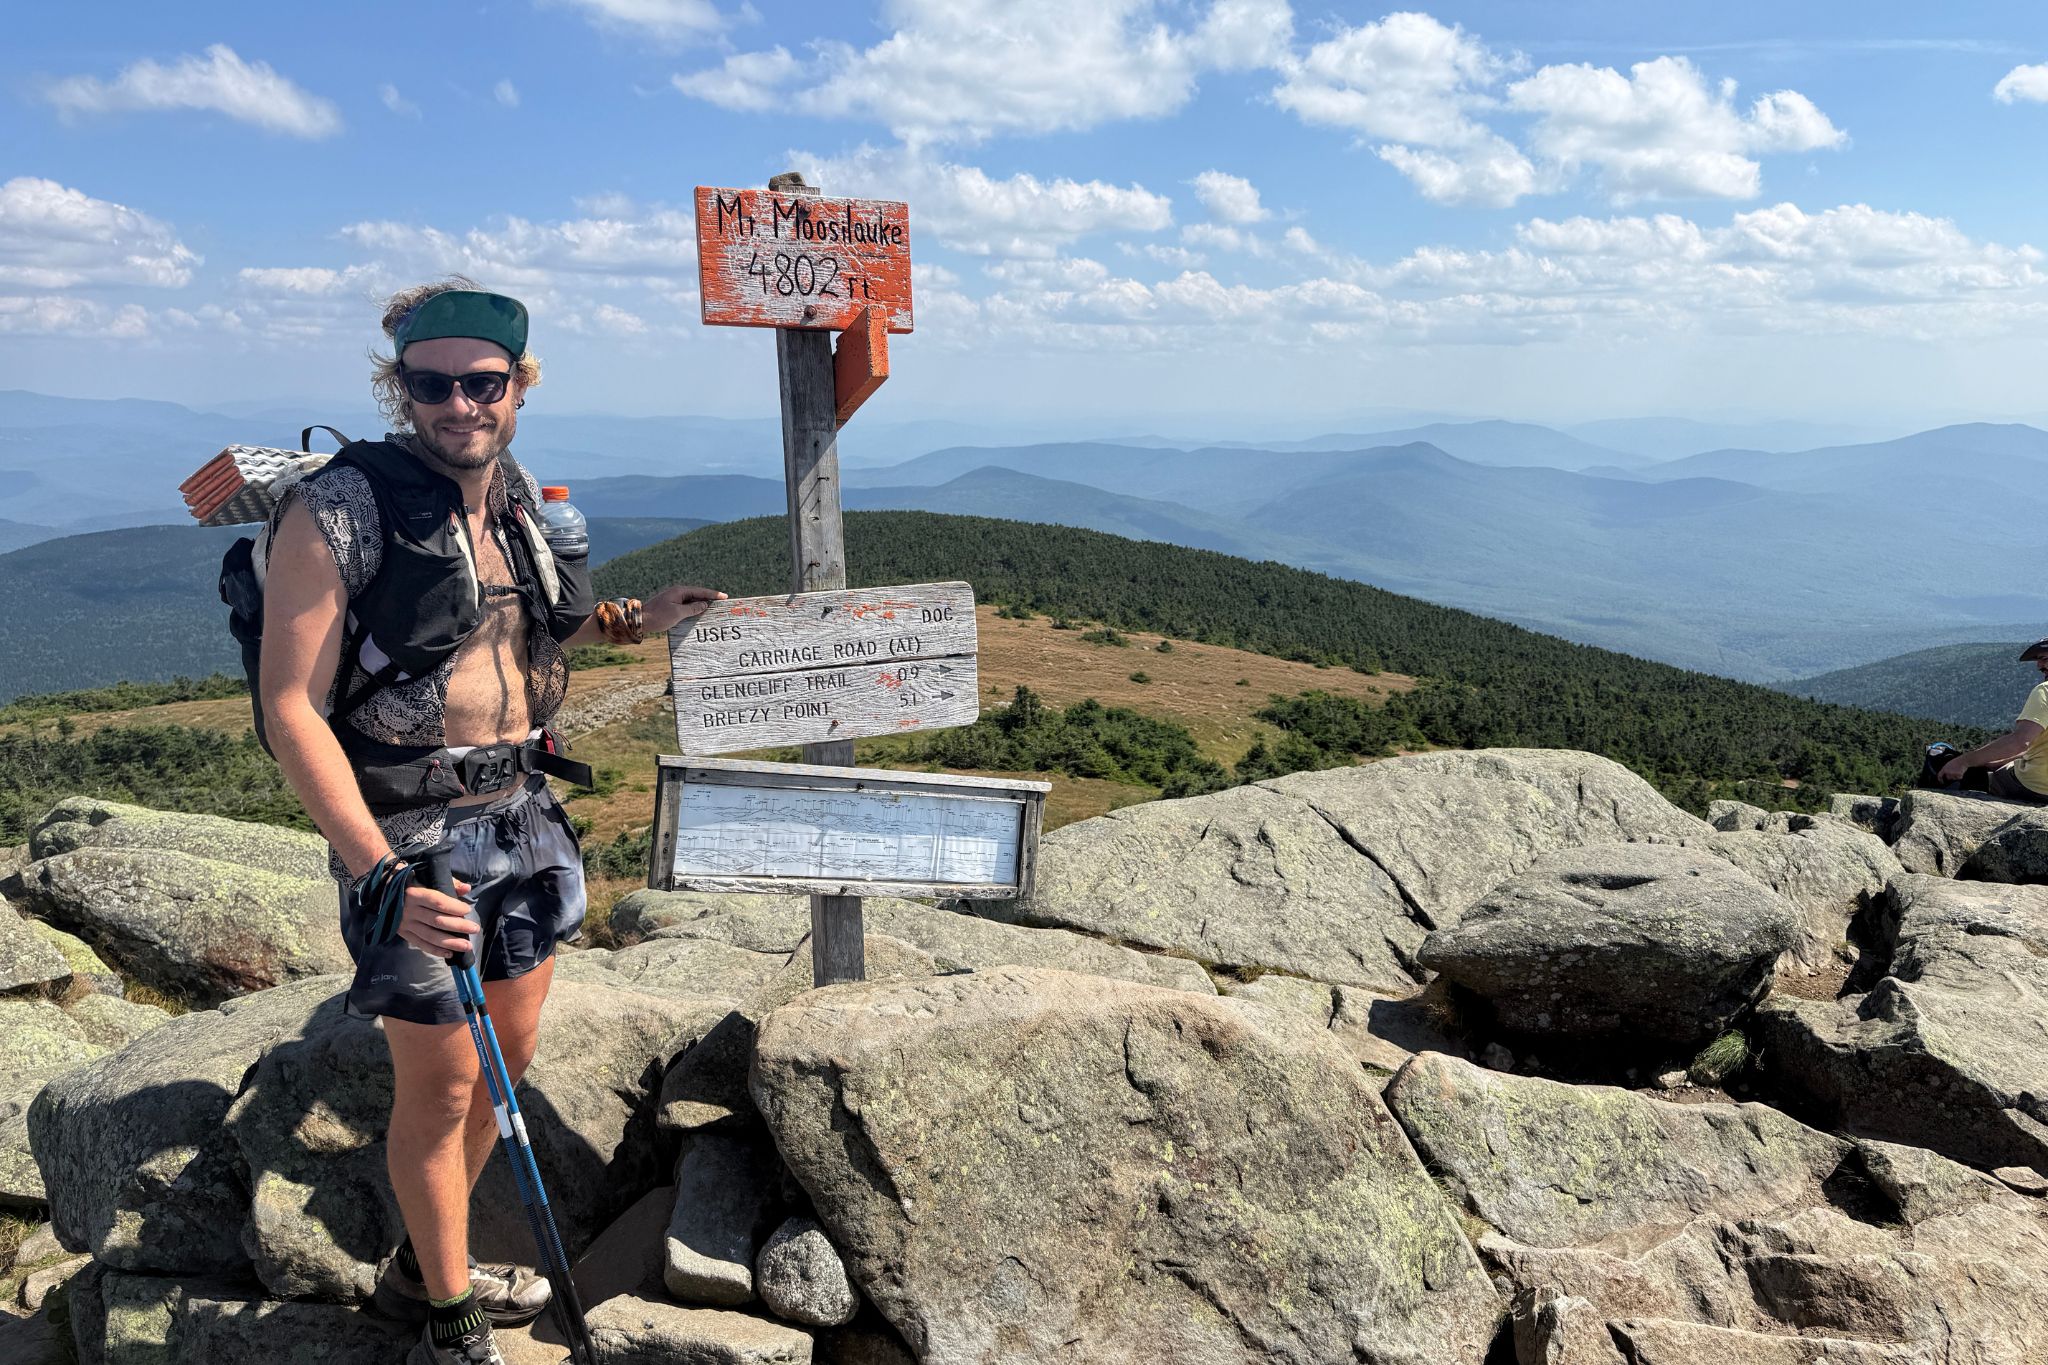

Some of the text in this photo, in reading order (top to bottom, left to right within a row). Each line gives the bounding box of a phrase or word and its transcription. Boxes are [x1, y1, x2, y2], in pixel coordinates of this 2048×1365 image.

[773, 198, 902, 246] Moosilauke
[749, 252, 839, 297] 4802
[922, 607, 953, 624] DOC
[696, 626, 742, 643] USES
[738, 636, 922, 668] CARRIAGE ROAD (AT)
[701, 677, 793, 701] GLENCLIFF
[804, 672, 851, 691] TRAIL
[703, 708, 770, 728] BREEZY
[783, 701, 831, 719] POINT
